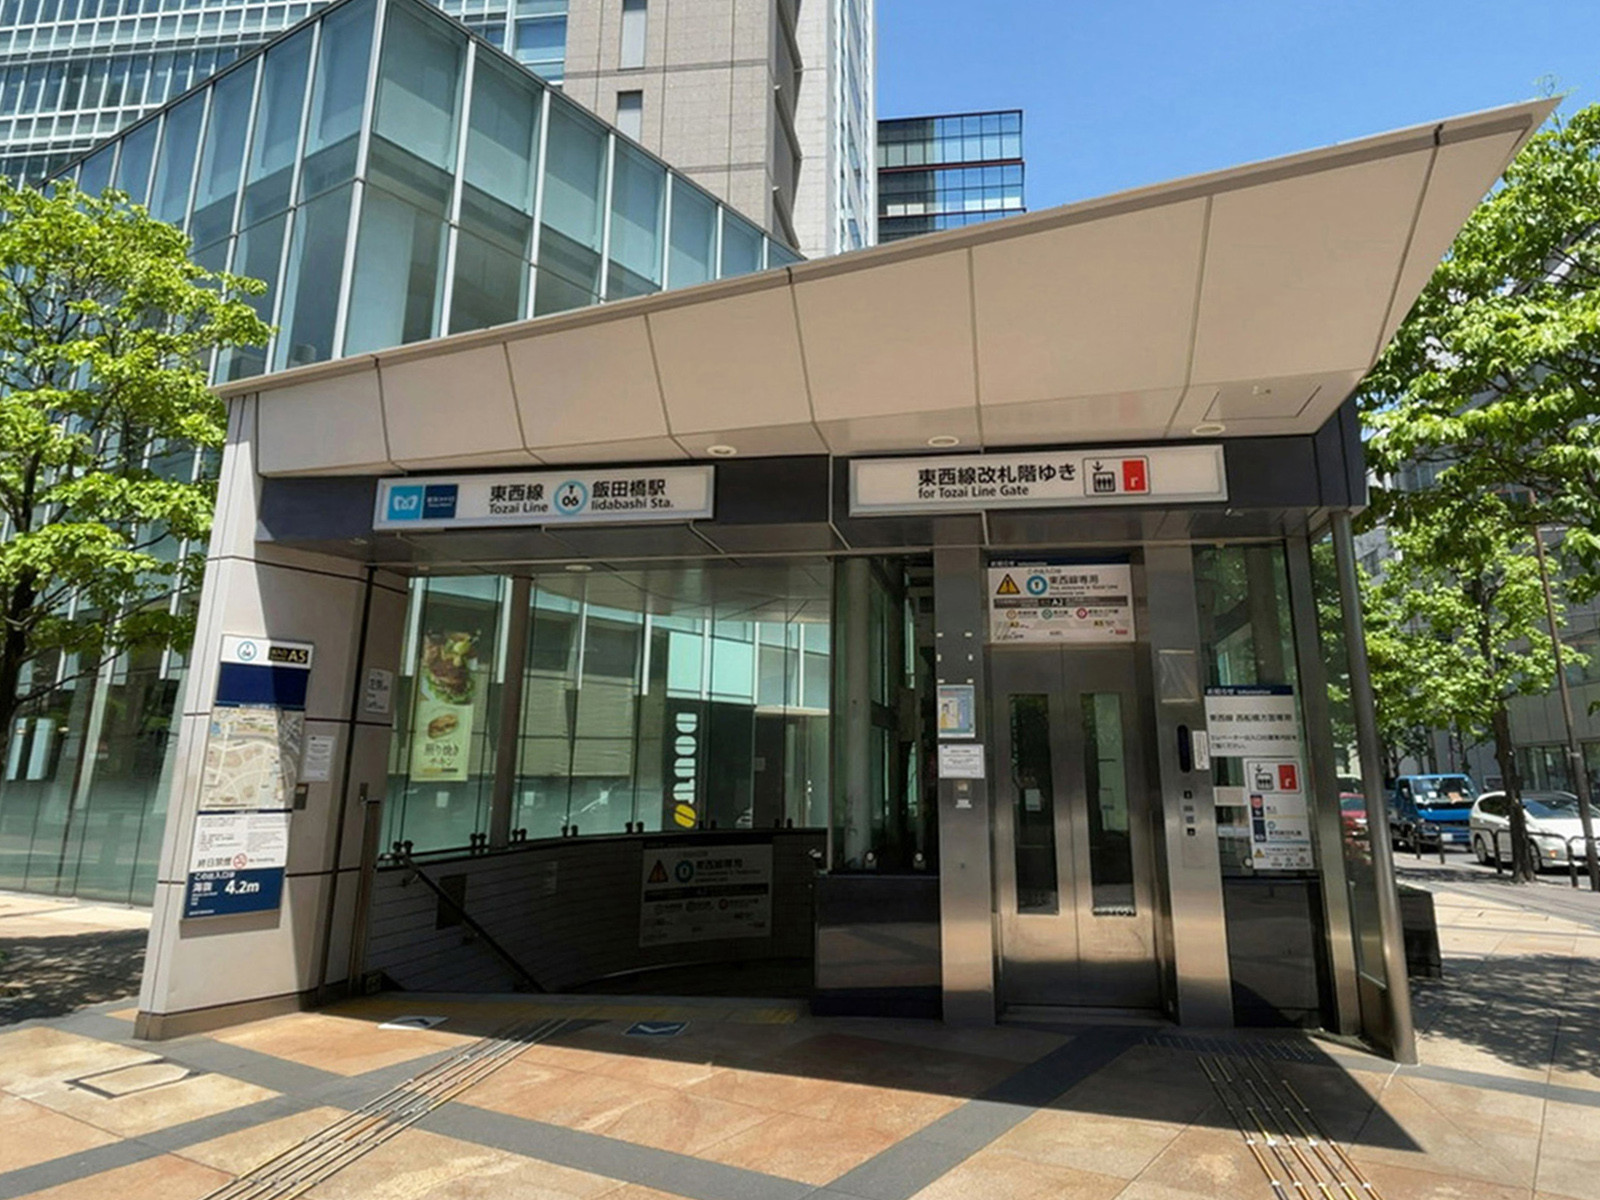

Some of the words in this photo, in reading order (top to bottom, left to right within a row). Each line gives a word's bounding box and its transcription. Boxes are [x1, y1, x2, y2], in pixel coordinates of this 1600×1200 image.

[918, 463, 1076, 485] 東西線改札階ゆき
[490, 483, 544, 502] 東西線
[568, 485, 575, 495] T
[592, 479, 666, 499] 飯田橋駅
[918, 486, 936, 499] for
[939, 486, 968, 499] Tozai
[971, 485, 997, 498] Line
[1000, 484, 1029, 497] Gate
[488, 502, 520, 514] Tozai
[523, 501, 549, 513] Line
[562, 495, 579, 507] 06
[591, 498, 648, 511] Iidabashi
[651, 497, 675, 509] Sta.
[288, 650, 307, 663] A5
[224, 879, 260, 895] 4.2m
